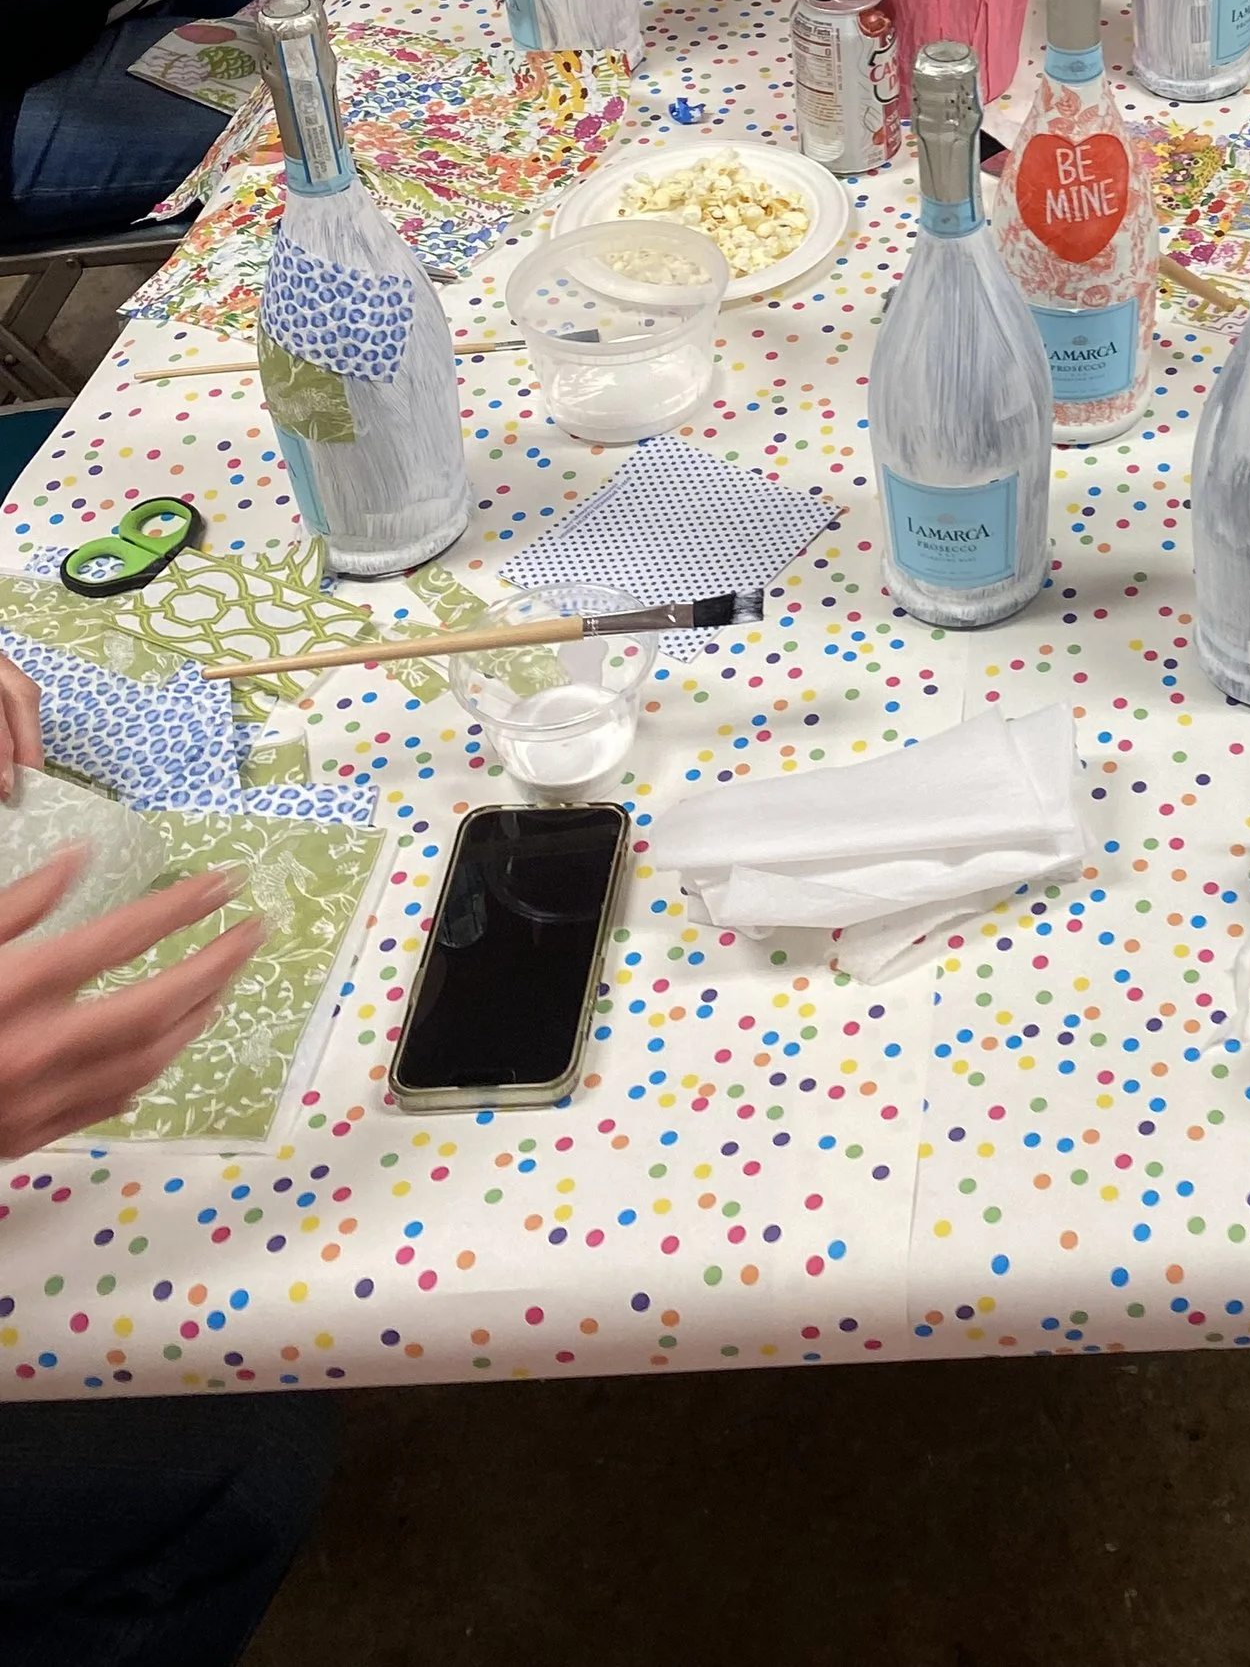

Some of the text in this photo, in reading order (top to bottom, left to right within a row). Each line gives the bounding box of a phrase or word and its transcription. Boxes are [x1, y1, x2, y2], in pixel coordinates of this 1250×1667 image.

[1056, 145, 1096, 185] BE
[1046, 178, 1119, 224] MINE
[1044, 341, 1118, 361] AMARCA
[917, 540, 977, 553] PROSECCO
